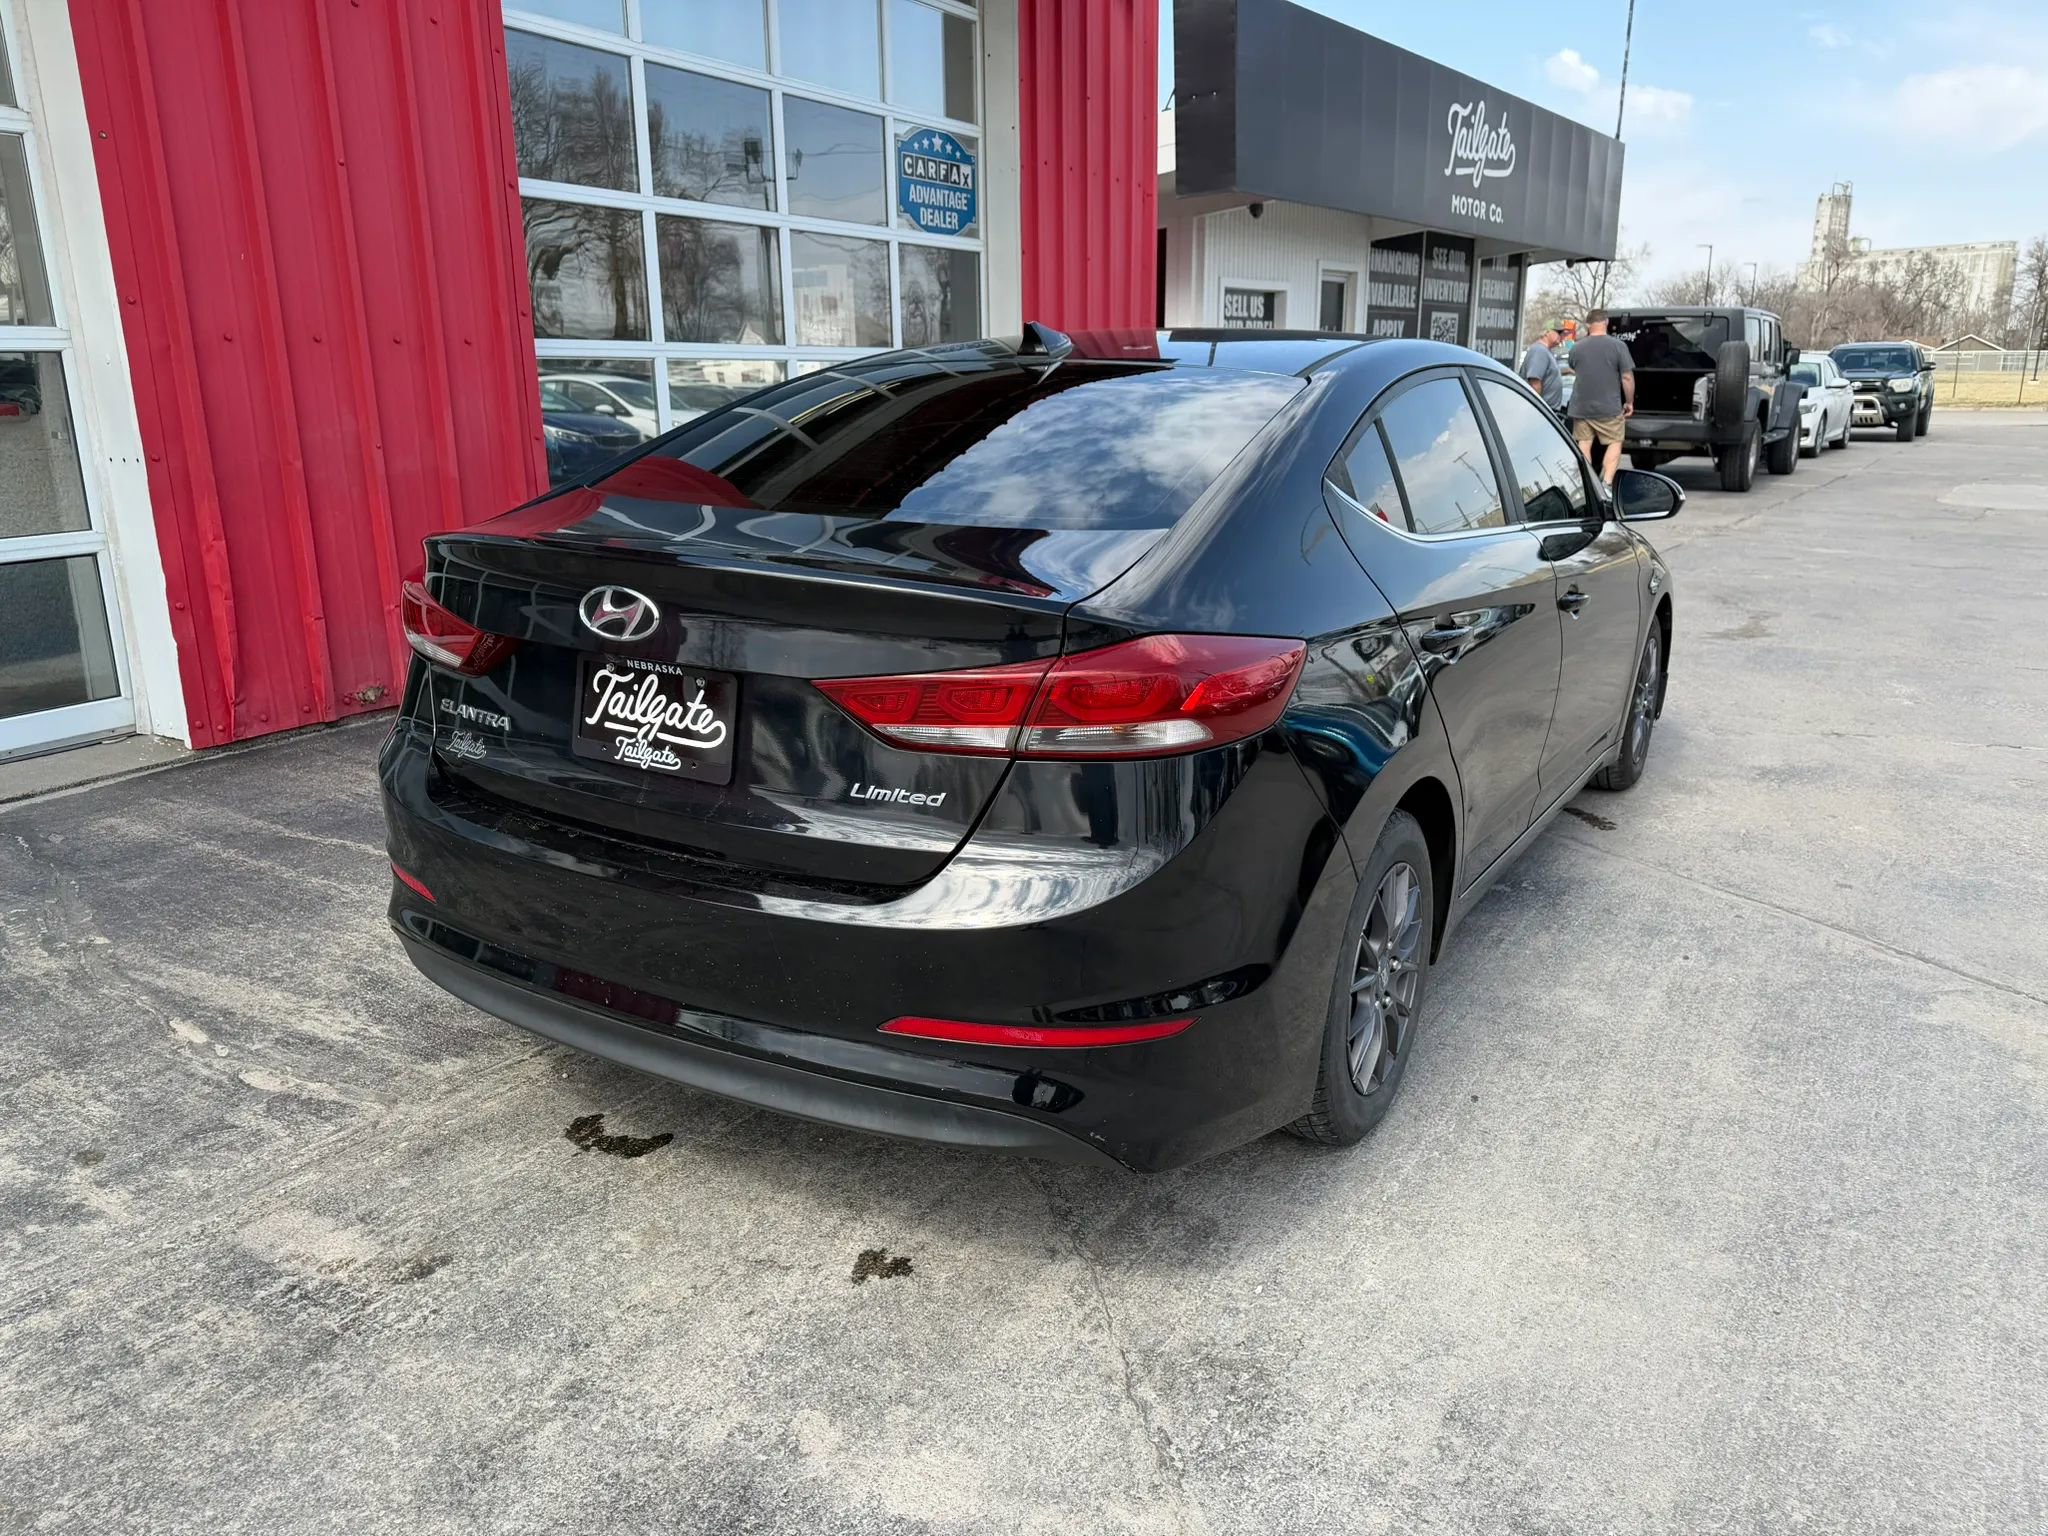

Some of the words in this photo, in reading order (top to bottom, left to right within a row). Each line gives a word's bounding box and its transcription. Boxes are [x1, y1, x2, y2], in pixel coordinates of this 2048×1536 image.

[1444, 100, 1516, 188] Tailgate
[904, 156, 970, 187] CARFAX
[909, 184, 969, 211] ADVANTAGE
[1451, 194, 1487, 220] MOTOR
[919, 207, 959, 230] DEALER
[1371, 247, 1420, 277] INANCING
[1432, 246, 1448, 270] SEE
[1448, 250, 1466, 272] OUR
[1423, 278, 1470, 304] INVENTORY
[1481, 279, 1514, 302] FREMONT
[1225, 294, 1249, 318] SELL
[1249, 295, 1265, 319] US
[1476, 307, 1515, 330] LOCATIONS
[626, 659, 684, 676] NEBRASKA
[440, 698, 512, 731] ELANTRA
[585, 669, 727, 749] Tailgate
[446, 730, 487, 760] Tailgate
[614, 736, 682, 770] Tailgate
[849, 783, 947, 807] Limited
